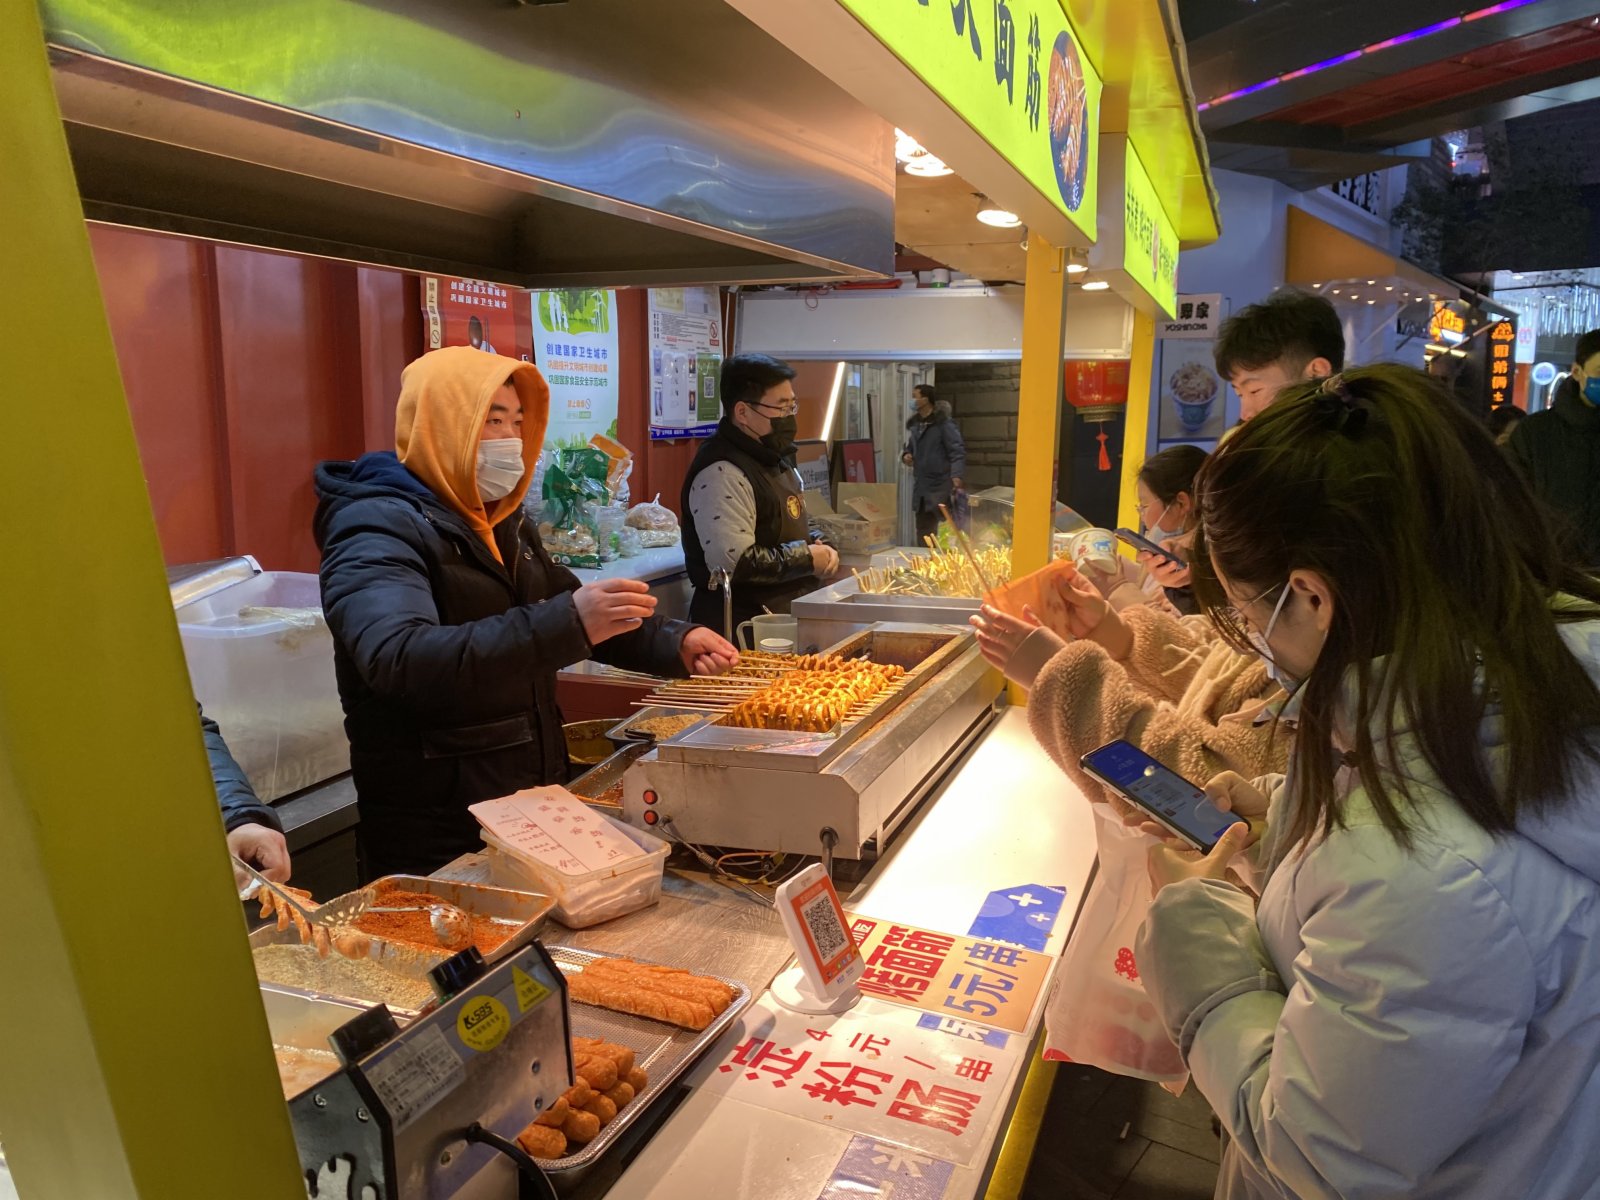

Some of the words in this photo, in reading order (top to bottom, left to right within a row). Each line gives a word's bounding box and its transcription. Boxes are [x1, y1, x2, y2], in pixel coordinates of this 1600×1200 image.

[546, 342, 608, 360] 创建国家卫生城市
[856, 925, 956, 1002] 烤面筋
[718, 1037, 982, 1136] 淀粉肠
